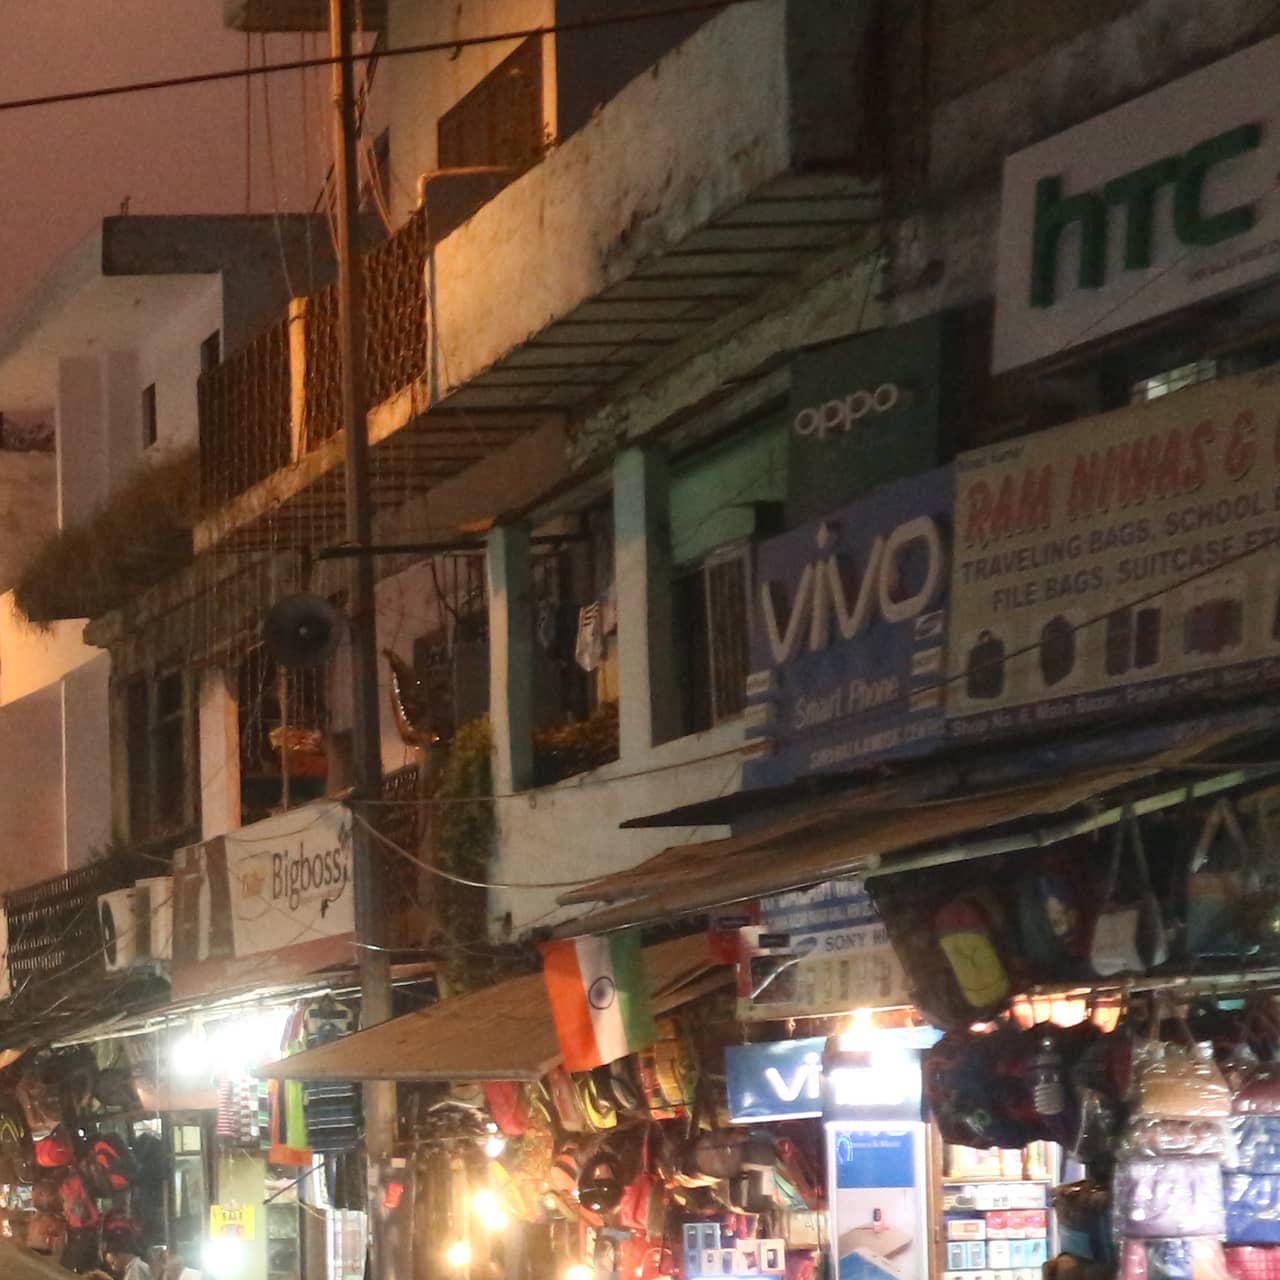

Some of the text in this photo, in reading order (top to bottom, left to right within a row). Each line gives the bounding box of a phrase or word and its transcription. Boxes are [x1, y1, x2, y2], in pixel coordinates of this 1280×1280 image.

[794, 383, 899, 439] oppo
[963, 462, 1056, 550] RAM
[1066, 420, 1212, 524] NIWAS
[960, 534, 1082, 587] TRAVELING
[1165, 491, 1264, 537] SCHOOL
[992, 580, 1039, 612] FILE
[1117, 536, 1239, 584] SUITCASE
[762, 515, 941, 664] vivo
[272, 840, 343, 912] Bigboss
[824, 931, 867, 952] SONY
[765, 1051, 823, 1102] vi
